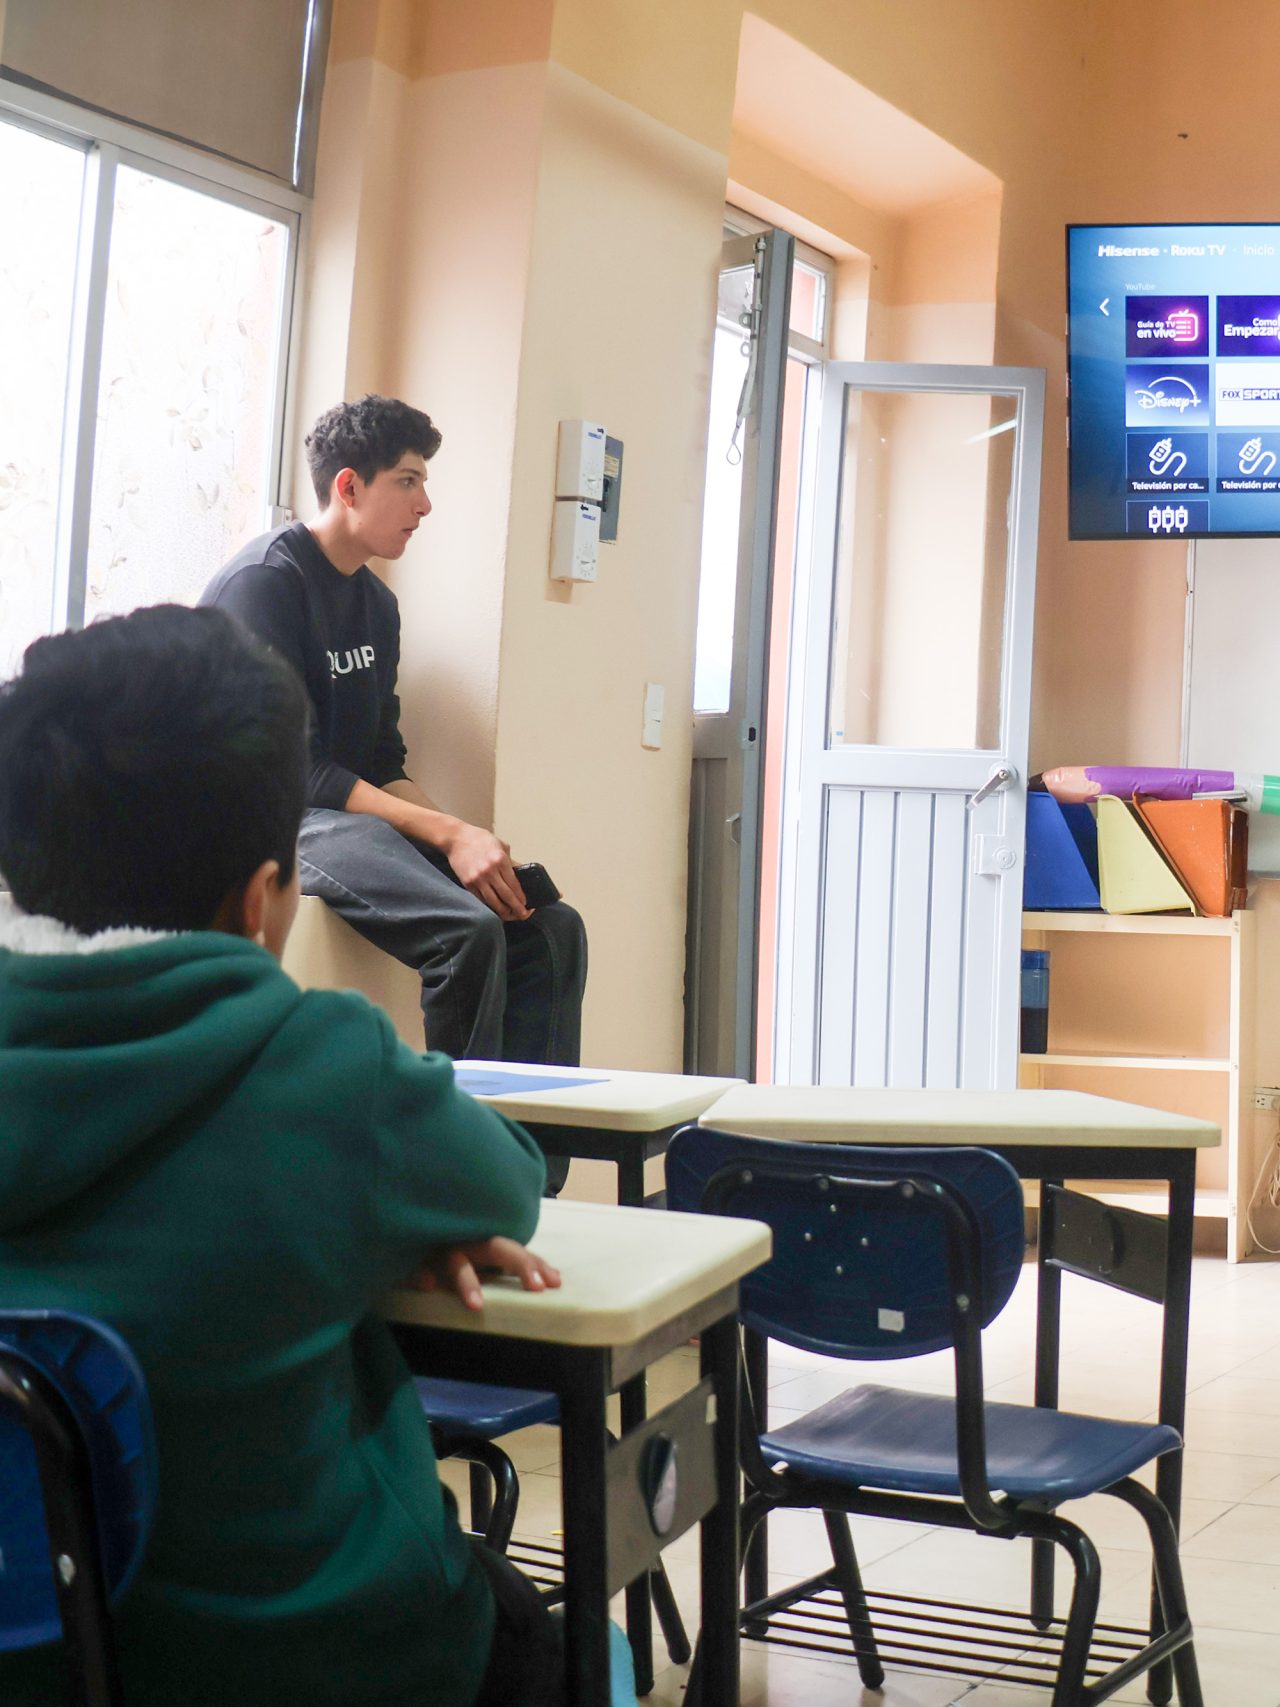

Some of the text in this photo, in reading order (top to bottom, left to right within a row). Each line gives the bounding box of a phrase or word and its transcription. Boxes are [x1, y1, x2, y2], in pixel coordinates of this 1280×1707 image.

[1098, 245, 1160, 257] Hisense
[1207, 245, 1226, 257] TV
[1243, 245, 1275, 256] Inicio
[1125, 283, 1155, 291] YouTube
[1165, 320, 1176, 328] TV
[1252, 317, 1278, 327] Como
[1136, 328, 1177, 339] en vivo
[1224, 323, 1280, 339] Empezar
[1221, 389, 1241, 400] FOX
[1132, 480, 1172, 490] Televisión
[1173, 481, 1186, 491] por
[1221, 480, 1261, 490] Televisión
[1262, 481, 1275, 491] por
